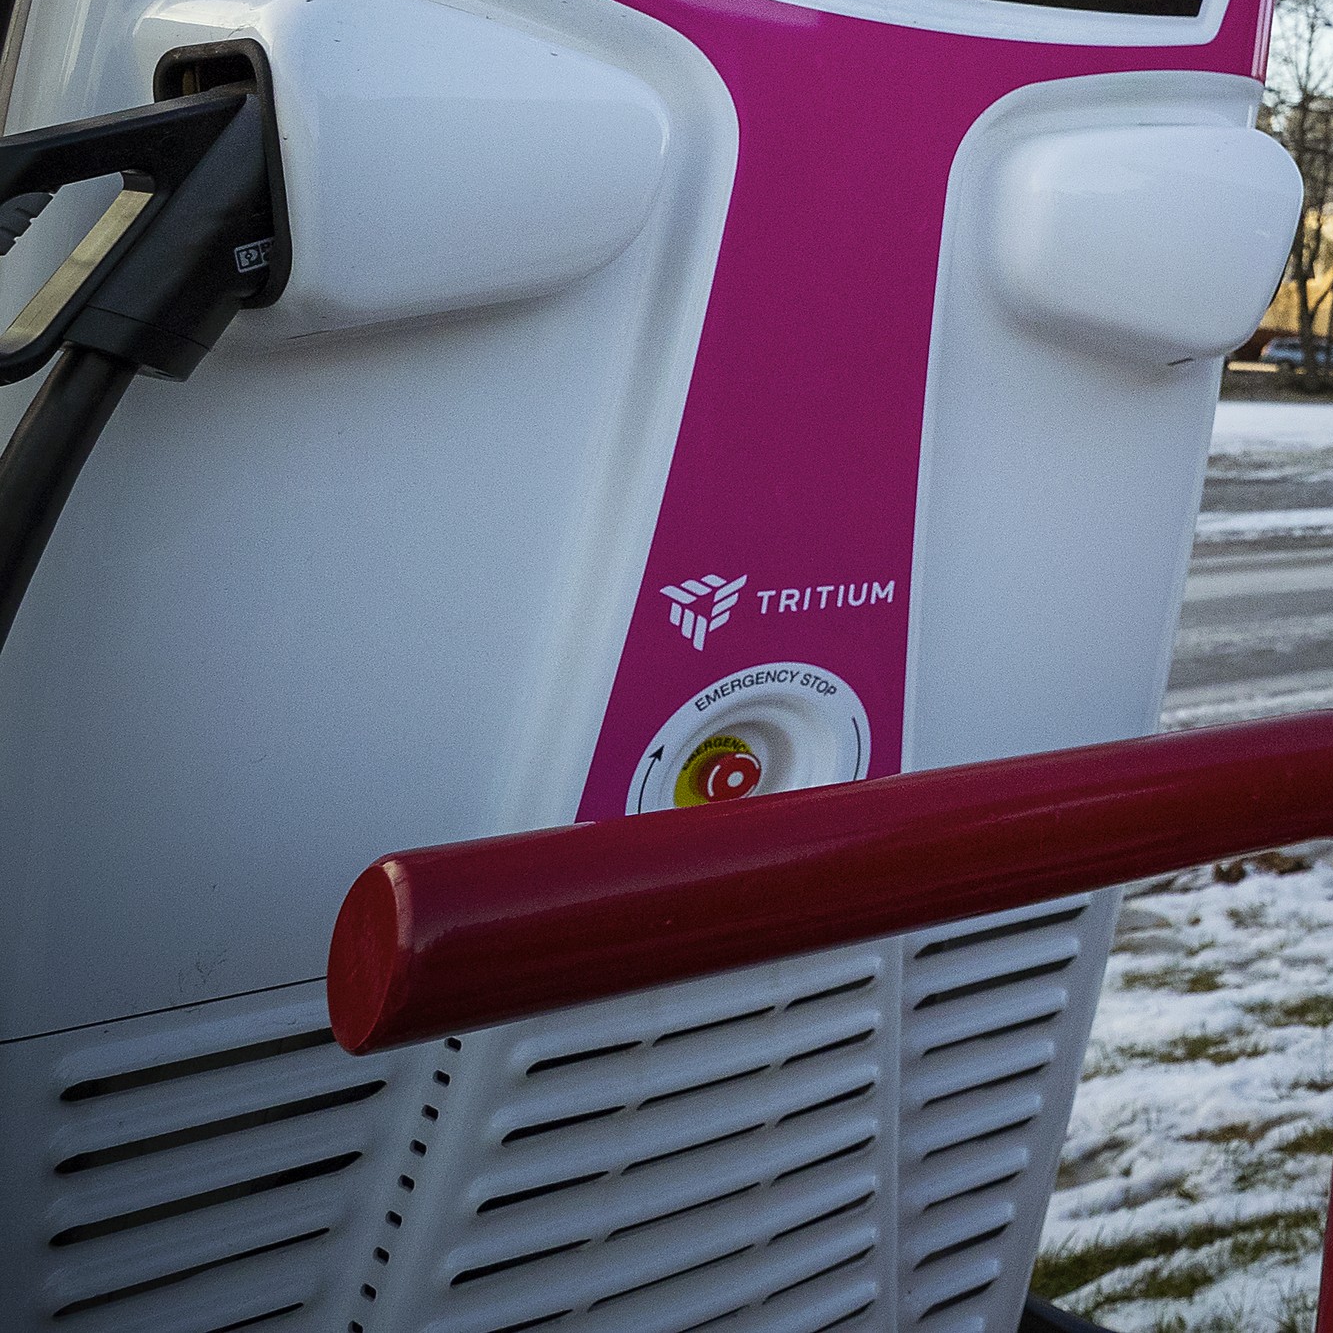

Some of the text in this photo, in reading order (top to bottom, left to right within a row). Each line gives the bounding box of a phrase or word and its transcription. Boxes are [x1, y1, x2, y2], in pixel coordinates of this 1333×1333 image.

[757, 580, 896, 615] TRITIUM
[695, 669, 838, 712] EMERGENCY STOP
